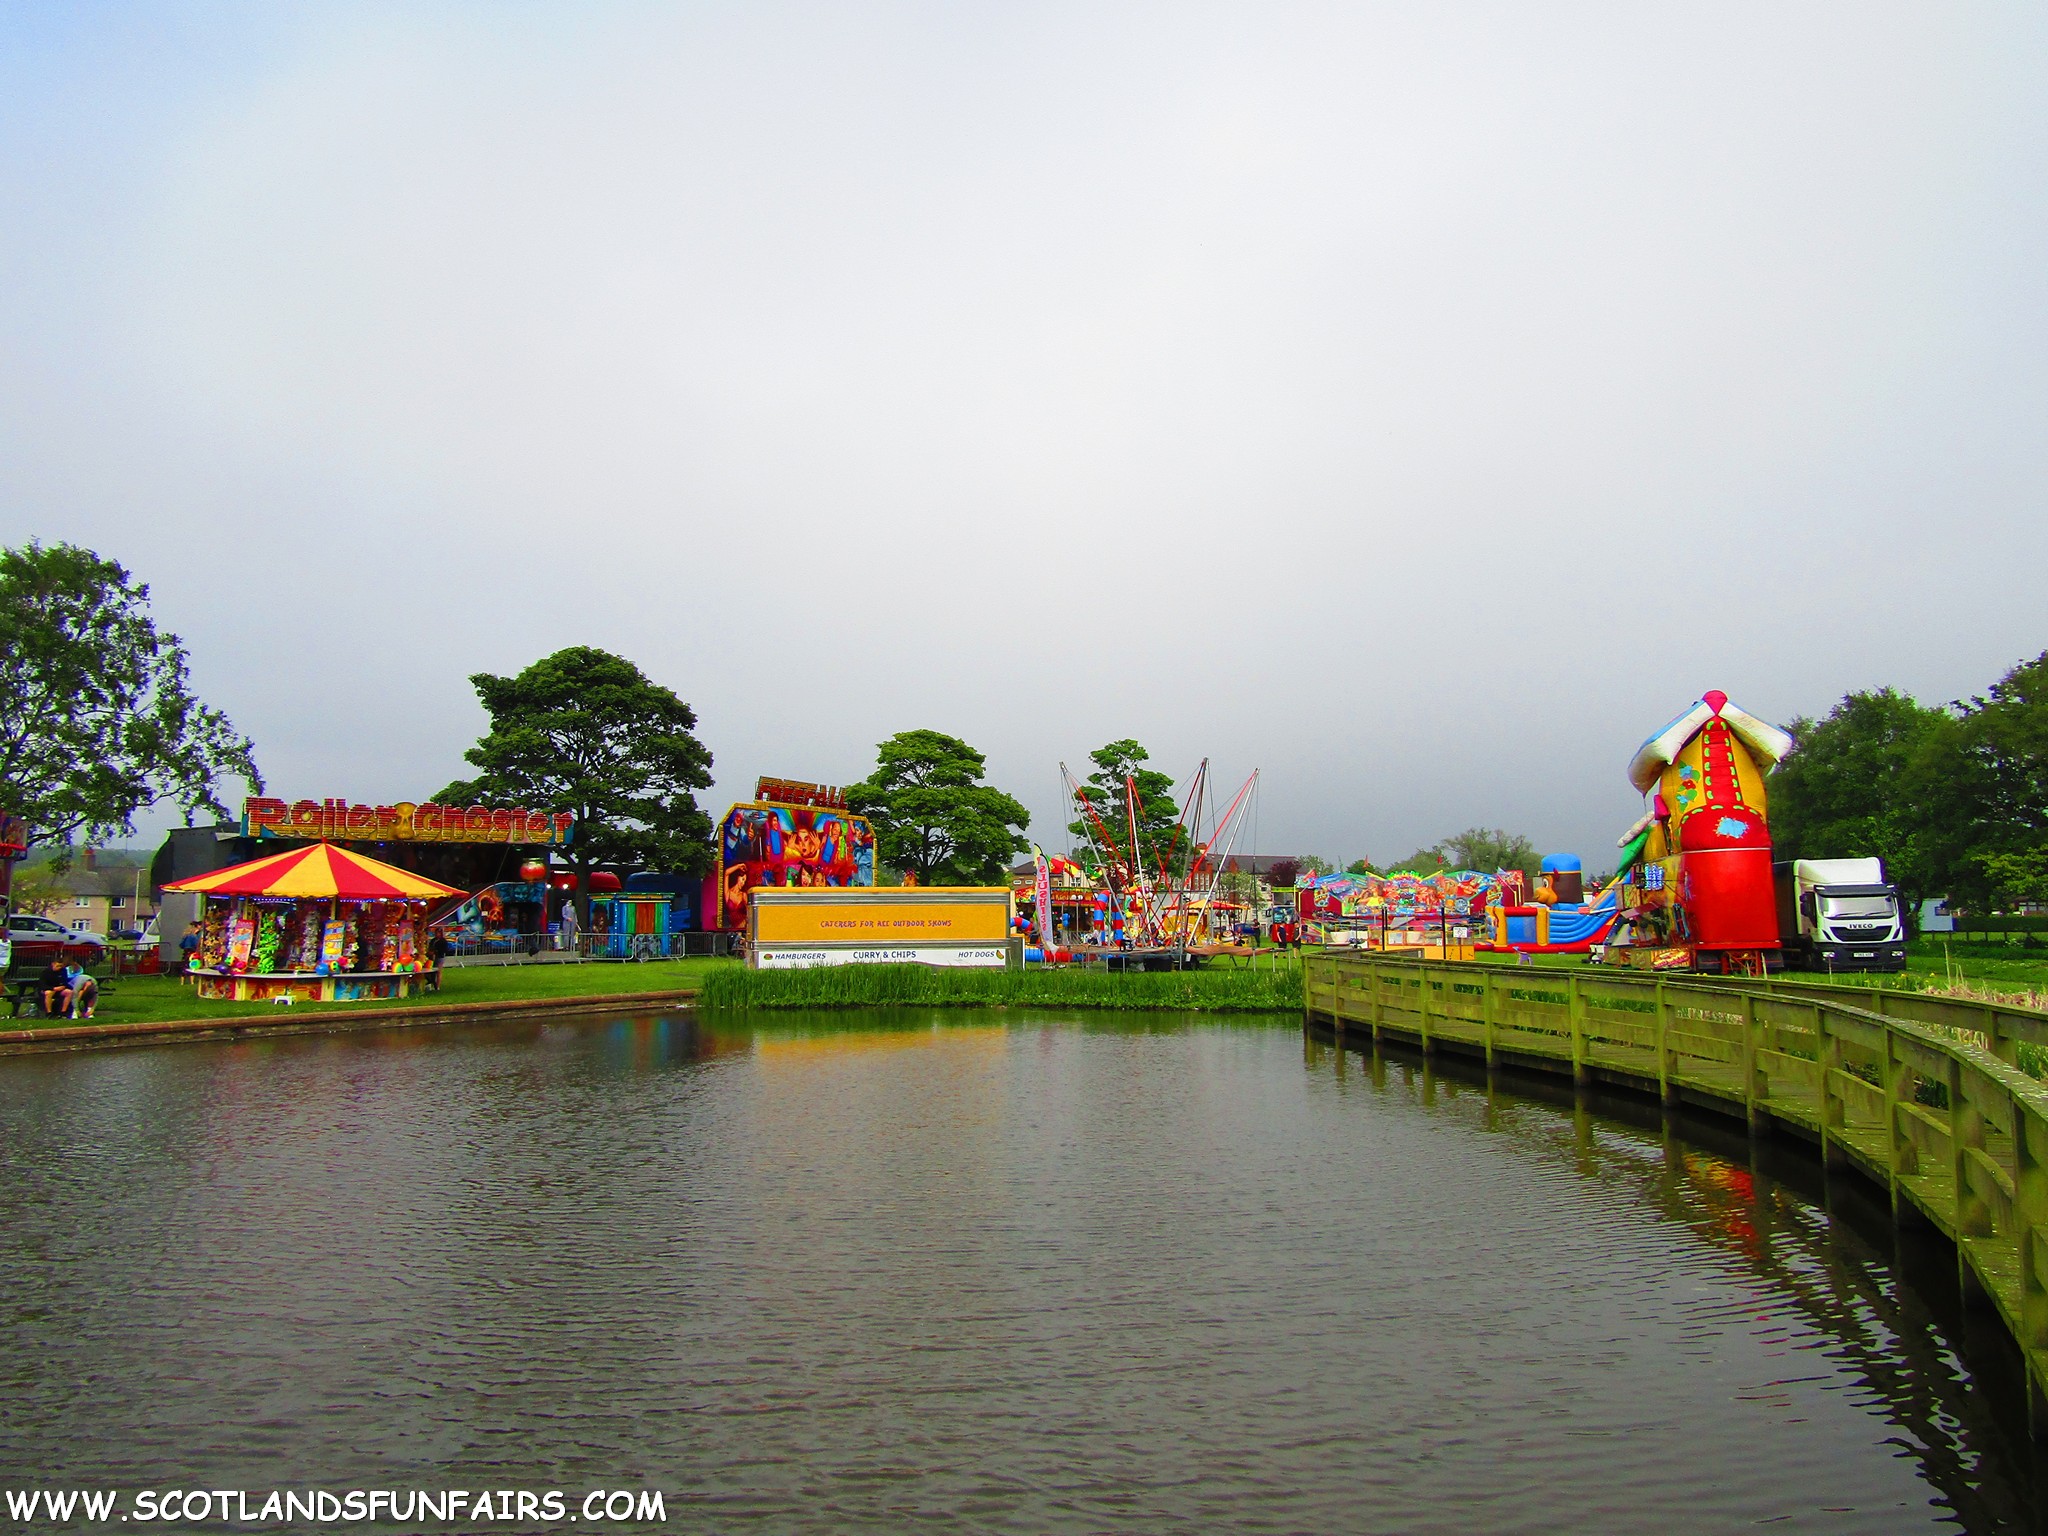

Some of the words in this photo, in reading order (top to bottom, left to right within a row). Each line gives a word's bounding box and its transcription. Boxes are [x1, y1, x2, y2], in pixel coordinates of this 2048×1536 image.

[244, 797, 397, 838] Roller
[413, 802, 573, 843] Ghoster
[820, 920, 857, 928] CATERERS
[859, 920, 874, 928] FOR
[893, 920, 925, 928] OUTDOOR
[928, 919, 952, 927] SHOWS
[774, 952, 827, 960] HAMBURGERS
[853, 951, 881, 959] CURRY
[883, 951, 889, 959] &
[891, 951, 917, 959] CHIPS
